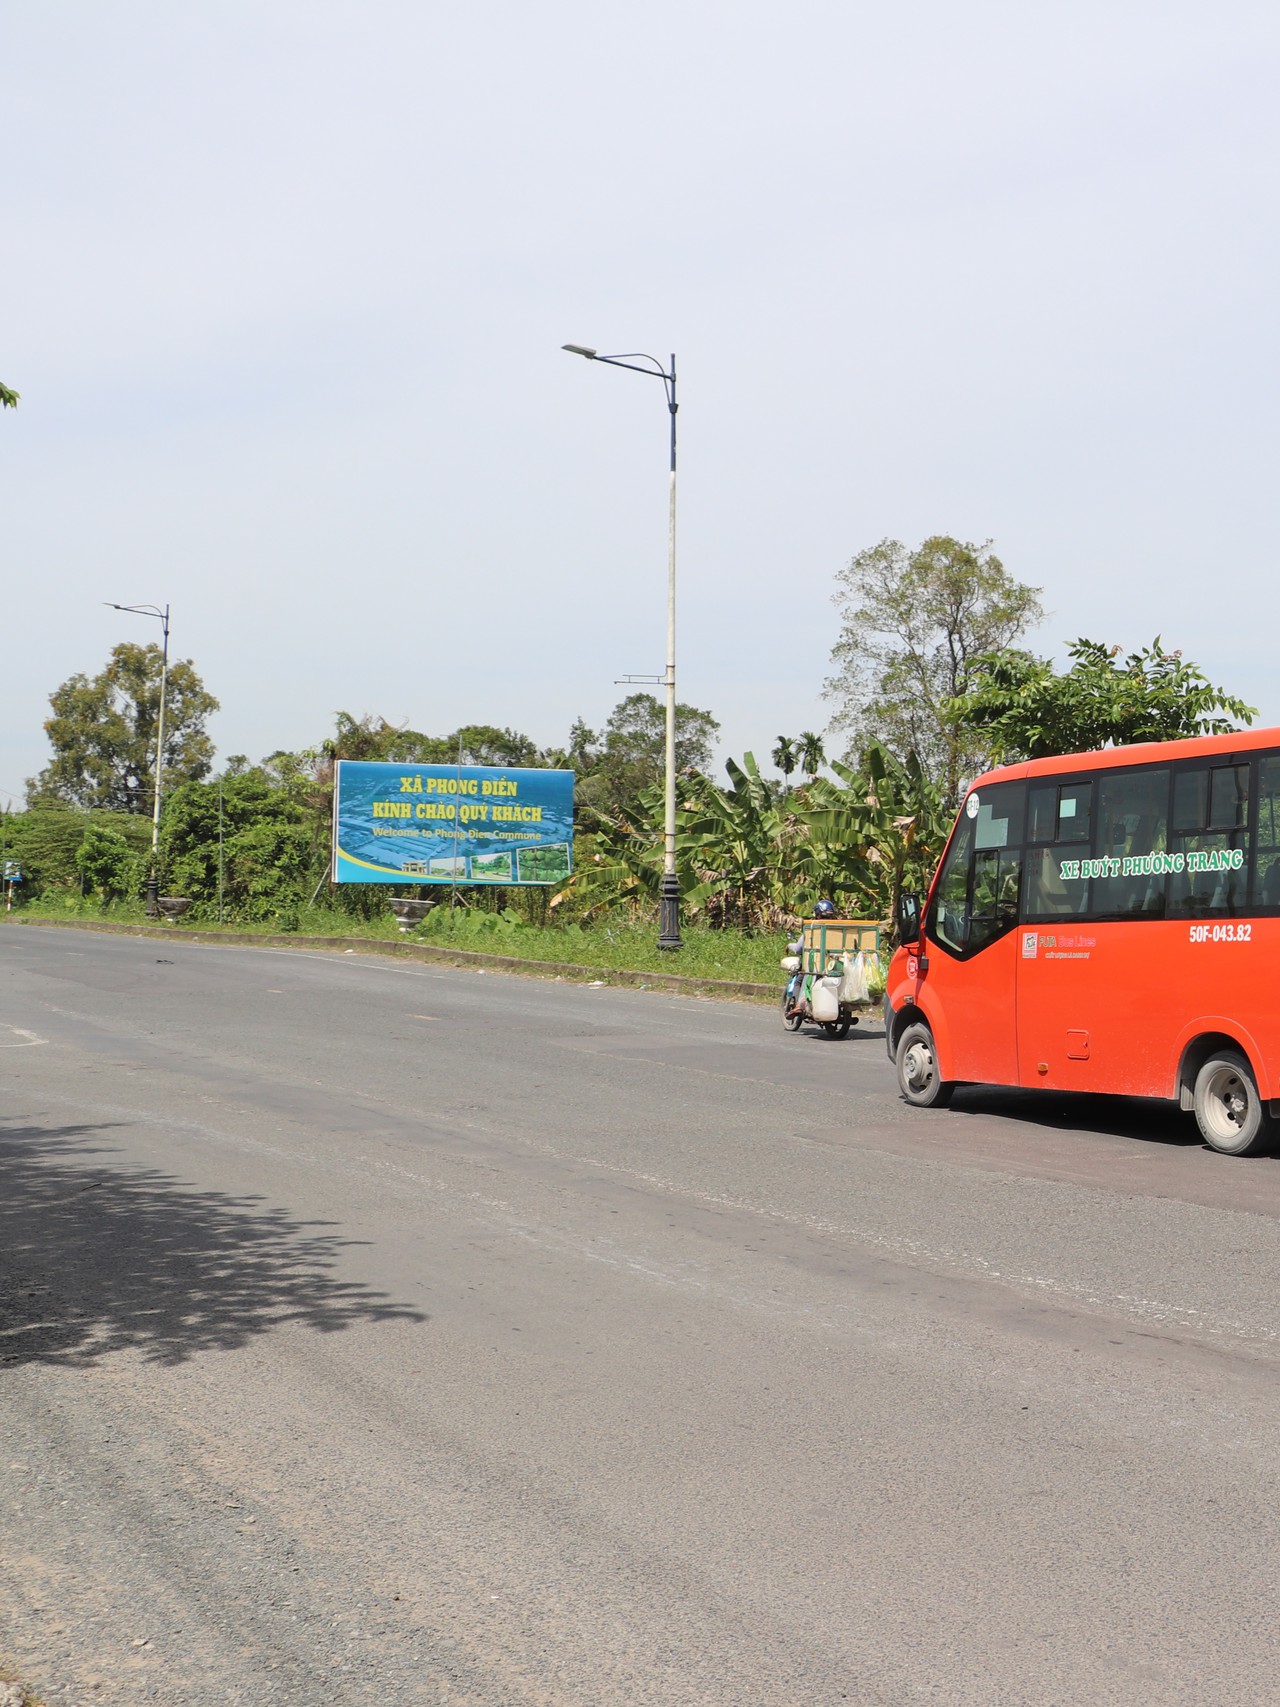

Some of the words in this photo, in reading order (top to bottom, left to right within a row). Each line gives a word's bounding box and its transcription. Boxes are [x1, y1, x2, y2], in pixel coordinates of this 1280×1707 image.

[400, 774, 423, 793] XÃ
[426, 778, 478, 795] PHONG
[372, 799, 412, 819] KÍNH
[416, 800, 455, 820] CHÀO
[459, 802, 489, 824] QUÝ
[492, 803, 542, 822] KHÁCH
[372, 827, 419, 838] Welcome
[422, 828, 433, 838] to
[435, 828, 466, 841] Phong
[493, 830, 541, 841] Commune
[1060, 860, 1079, 880] XE
[1081, 855, 1120, 878] BUÝT
[1123, 851, 1184, 876] PHƯƠNG
[1186, 849, 1243, 872] TRANG
[1039, 936, 1057, 948] FUTA
[1058, 935, 1074, 947] Bus
[1075, 935, 1097, 947] Lines
[1189, 924, 1252, 942] 50F-043.82
